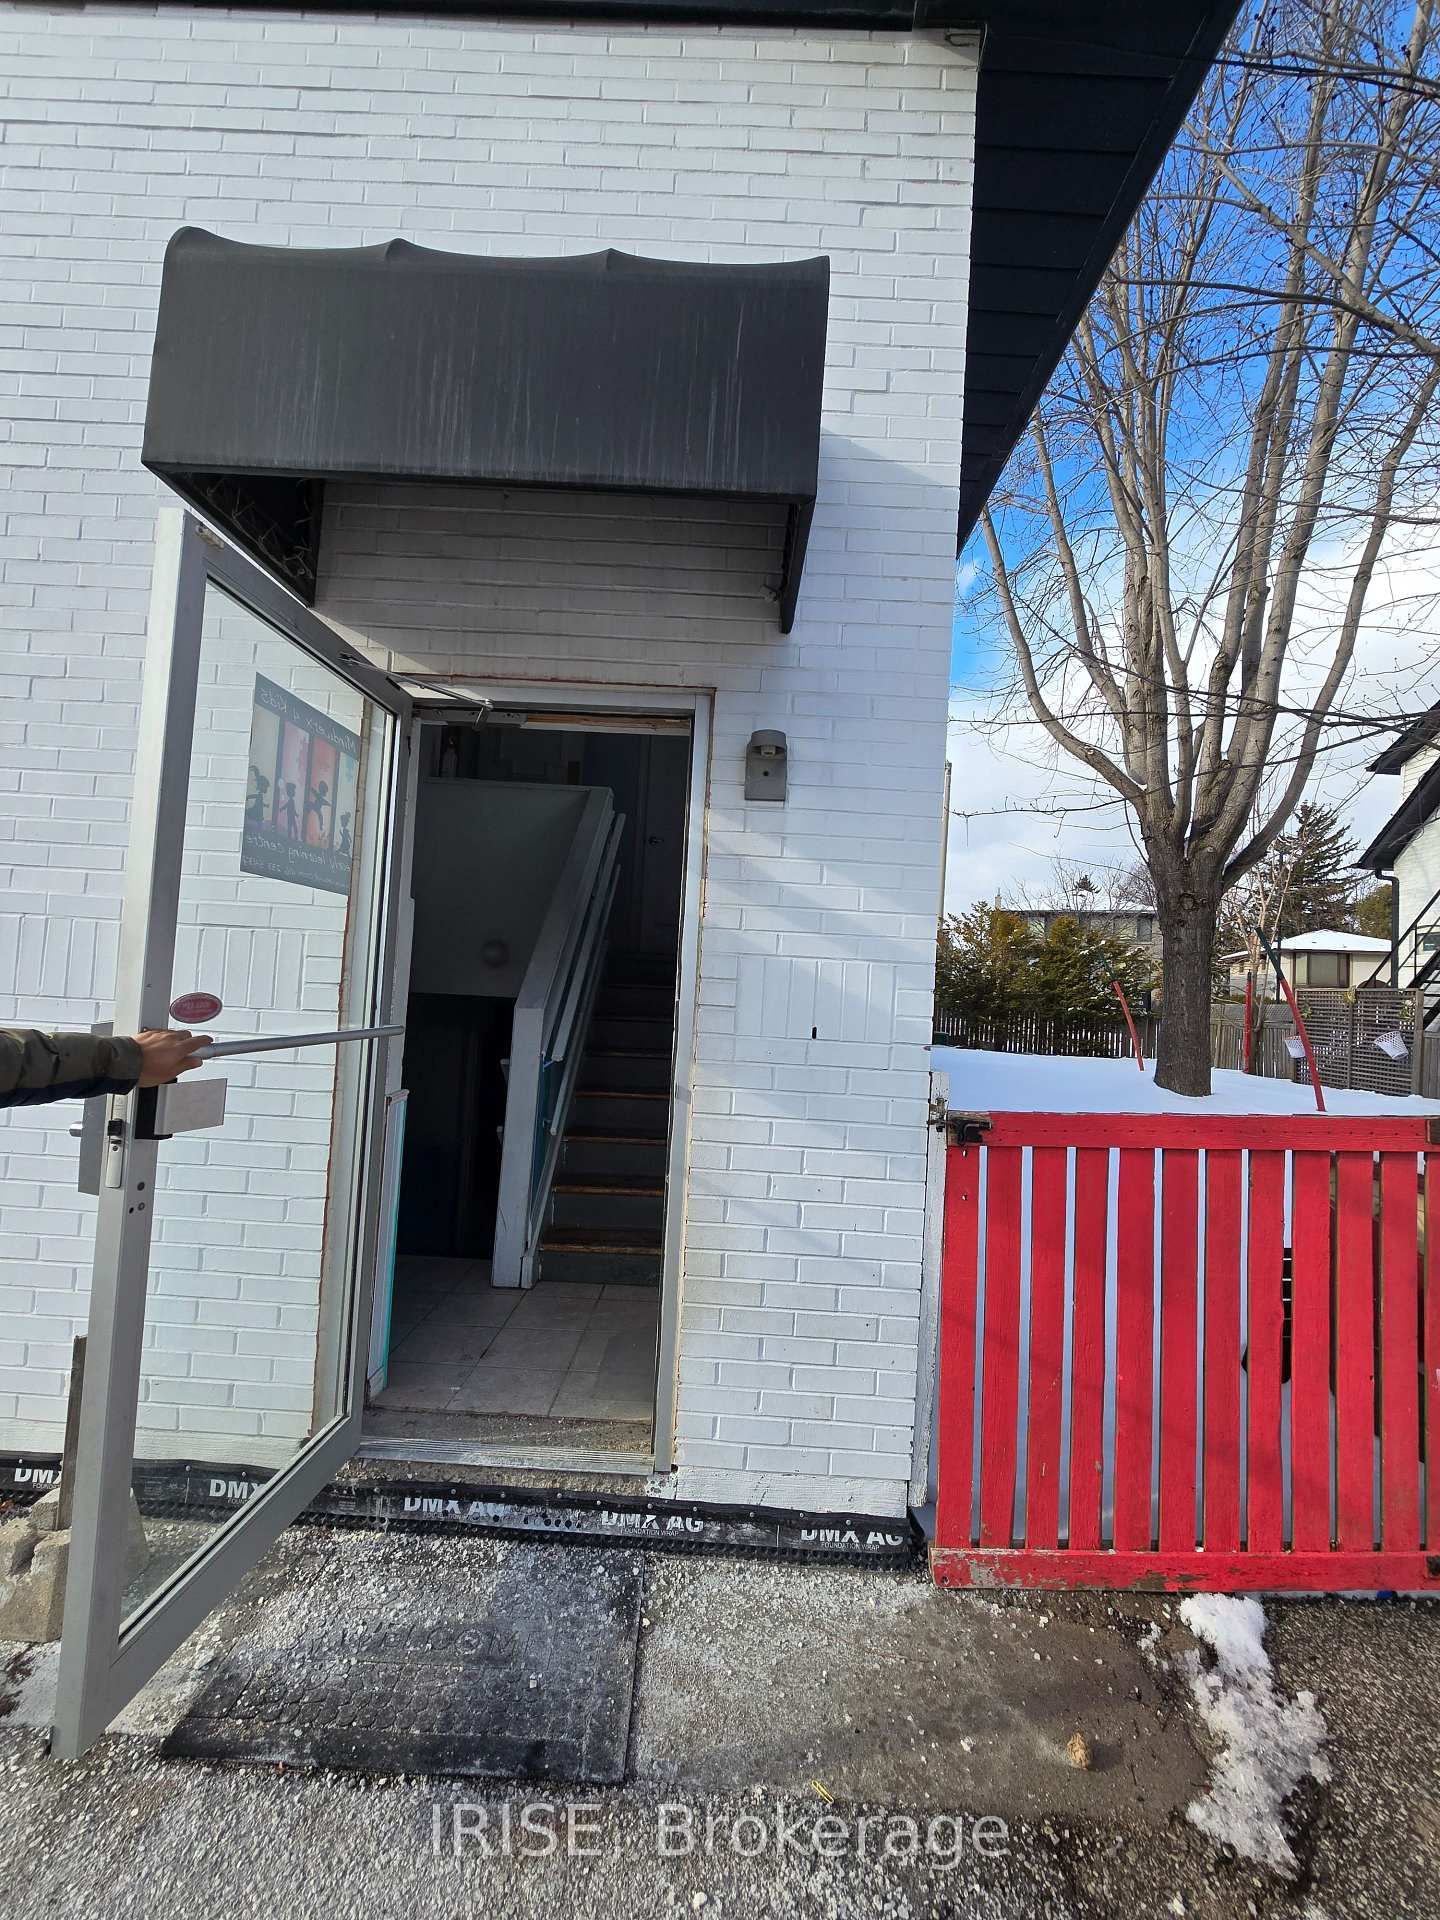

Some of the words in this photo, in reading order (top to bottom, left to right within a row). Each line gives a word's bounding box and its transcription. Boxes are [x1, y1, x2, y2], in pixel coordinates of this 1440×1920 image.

[404, 1497, 461, 1514] DMX
[601, 1510, 660, 1530] DMX
[666, 1516, 704, 1533] AG
[821, 1541, 861, 1551] FOUNDATION
